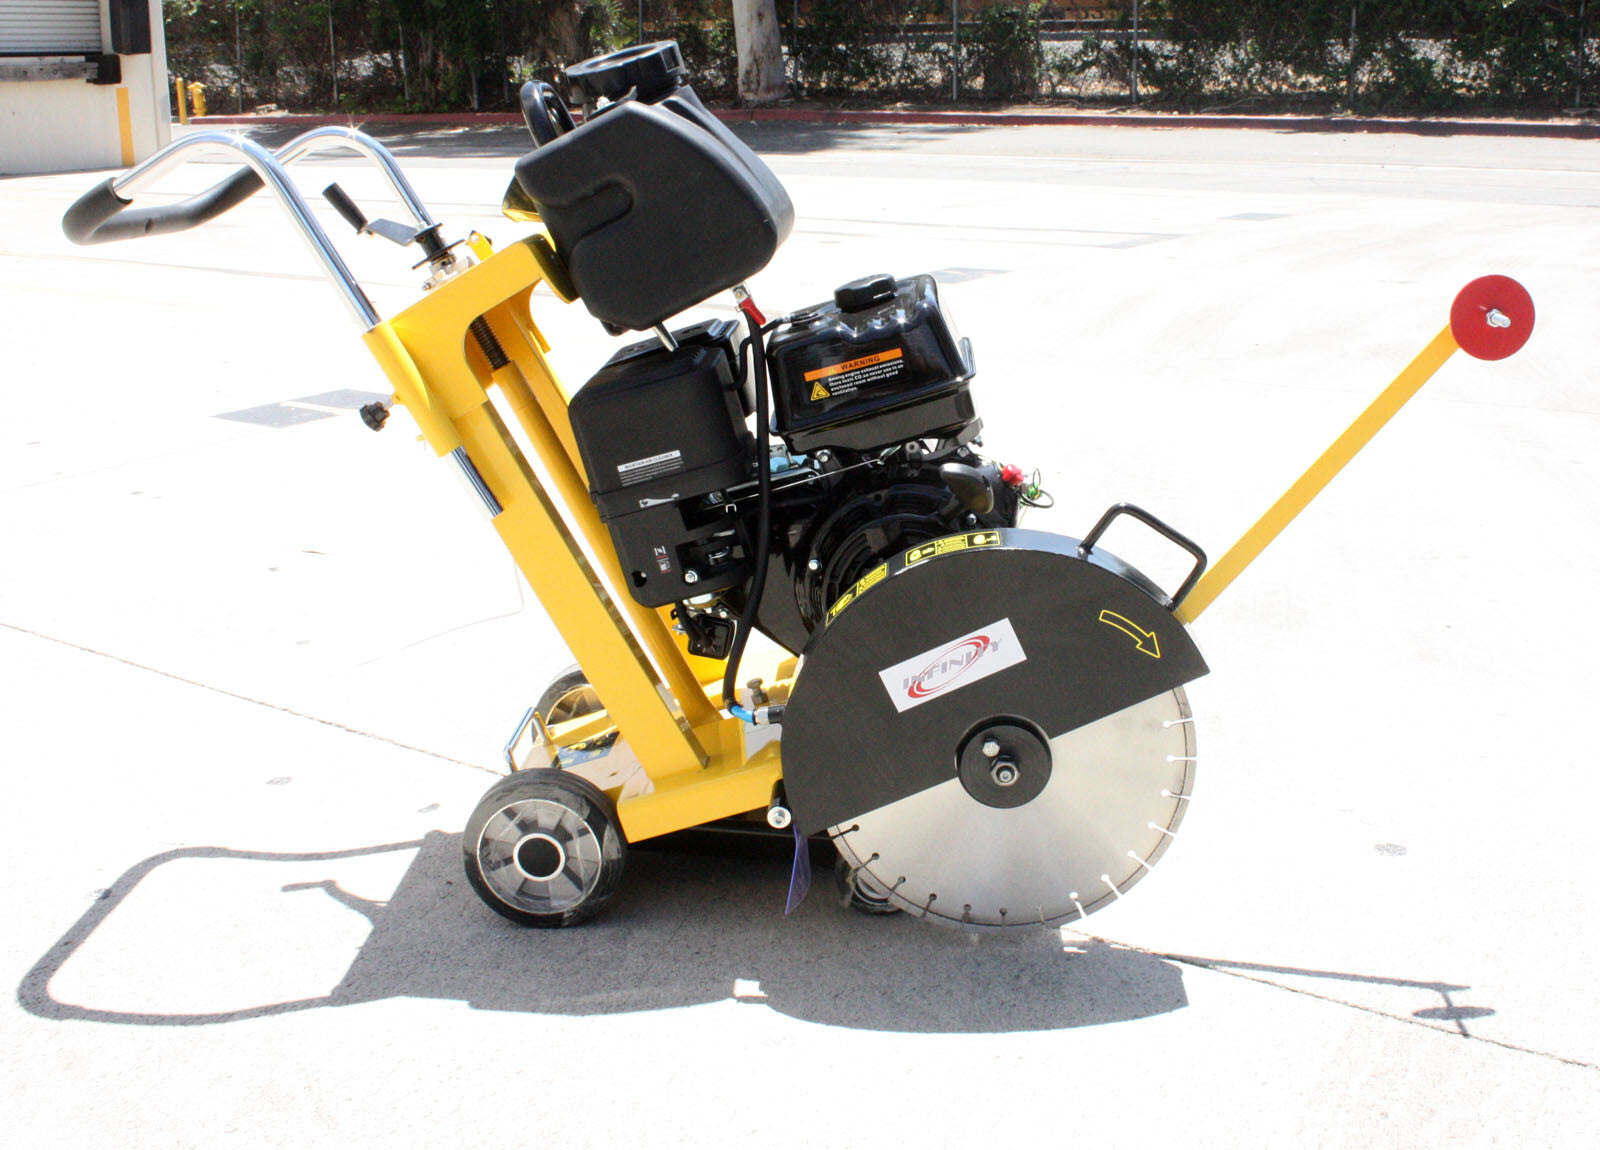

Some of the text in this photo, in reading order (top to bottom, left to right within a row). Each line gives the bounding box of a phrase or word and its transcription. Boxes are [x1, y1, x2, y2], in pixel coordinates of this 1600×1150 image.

[840, 355, 881, 370] WARNING
[886, 370, 899, 378] good
[902, 637, 1002, 691] INFINITY
